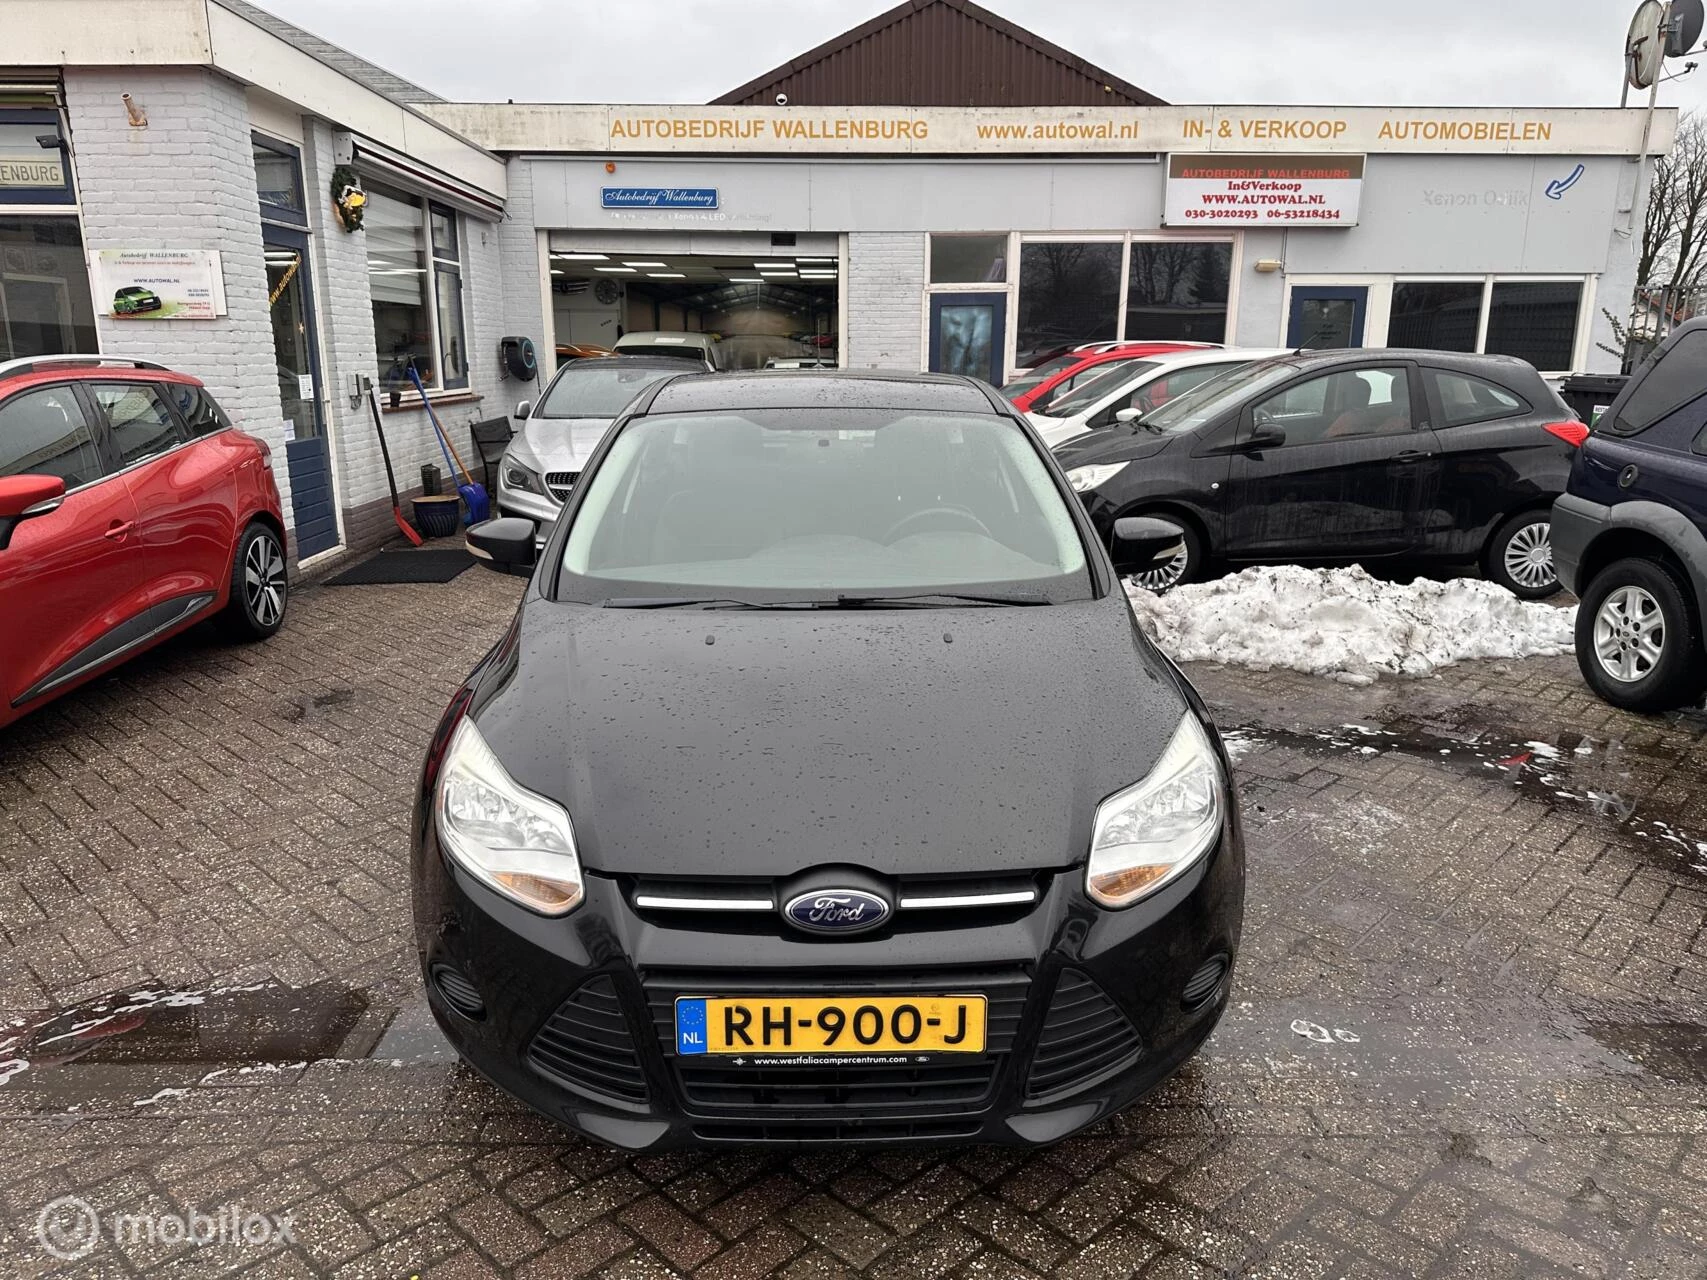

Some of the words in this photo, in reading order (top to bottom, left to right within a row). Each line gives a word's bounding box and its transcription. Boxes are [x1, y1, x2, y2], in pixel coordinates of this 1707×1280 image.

[610, 119, 764, 138] AUTOBEDRIJF
[772, 120, 928, 139] WALLENBURG
[977, 121, 1138, 139] www.autowal.nl
[1183, 120, 1211, 137] IN-
[1217, 120, 1232, 138] &
[1240, 121, 1346, 138] VERKOOP
[1378, 121, 1552, 140] AUTOMOBIELEN
[0, 165, 59, 181] ENBURG
[1182, 168, 1264, 178] AUTOBEDRIJF
[1267, 169, 1350, 178] WALLENBURG
[605, 190, 661, 205] Autobedrijf
[662, 189, 714, 205] Wallenburg
[1202, 194, 1326, 205] WWW.AUTOWAL.NL
[1185, 209, 1259, 219] 030-3020293
[1267, 209, 1340, 219] 06-53218434
[809, 897, 865, 921] Ford
[683, 1032, 703, 1044] NL
[724, 1004, 967, 1046] RH-900-J
[754, 1055, 908, 1066] www.westfaliacampercentrum.com
